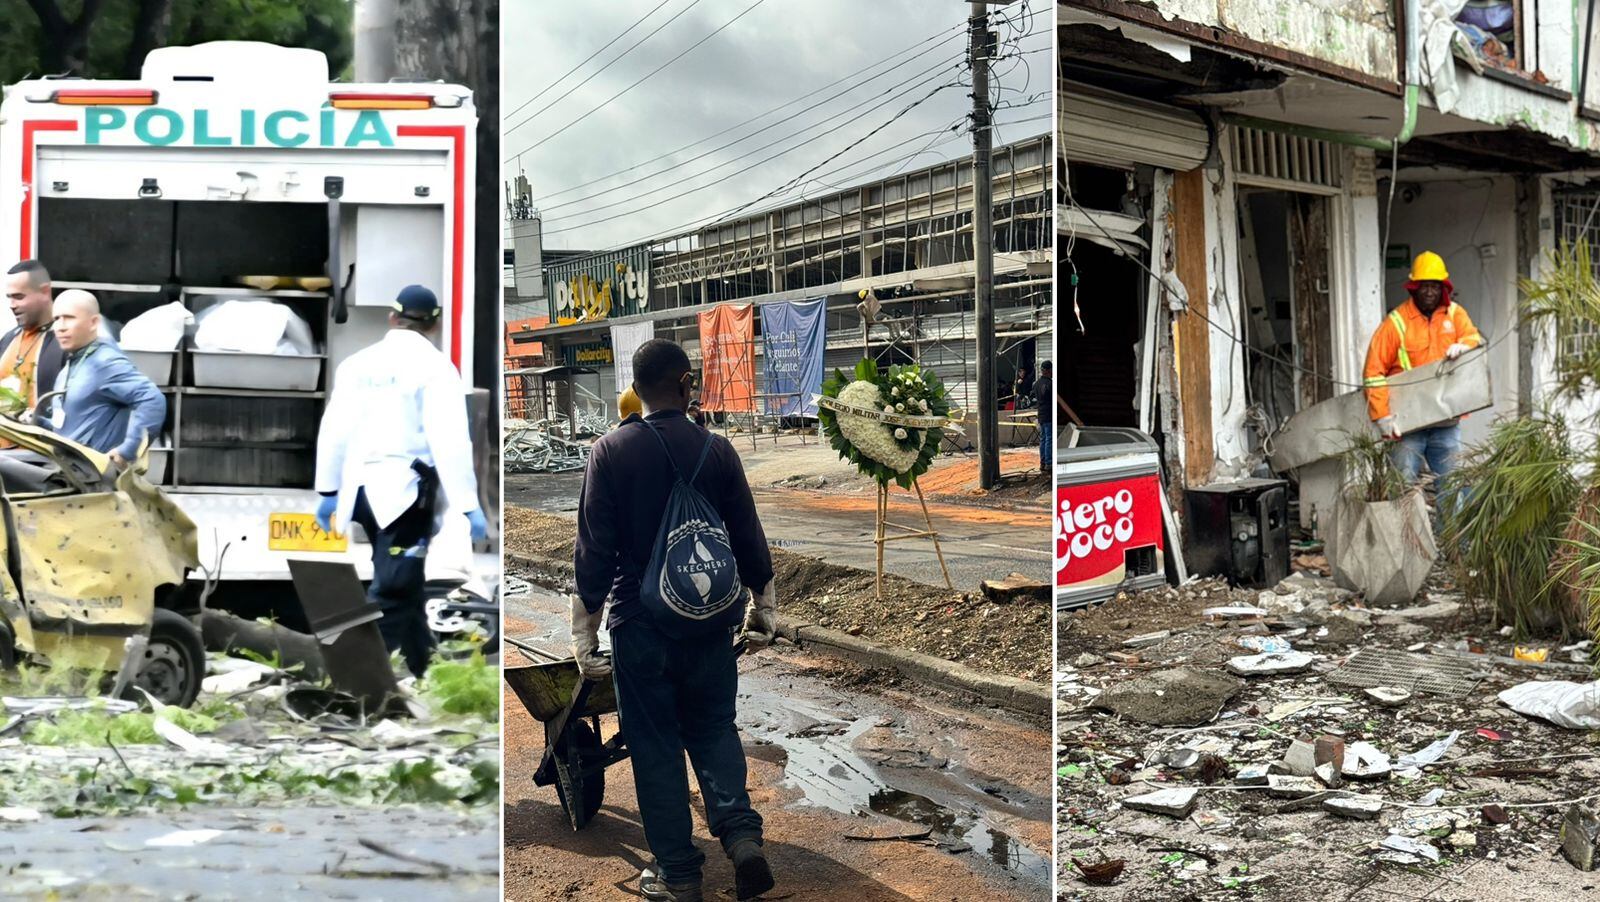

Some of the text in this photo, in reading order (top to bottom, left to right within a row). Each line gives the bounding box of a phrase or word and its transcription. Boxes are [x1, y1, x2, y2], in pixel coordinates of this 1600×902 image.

[84, 101, 395, 147] POLICÍA
[852, 407, 881, 420] MILITAR
[676, 559, 728, 574] SKECHERS
